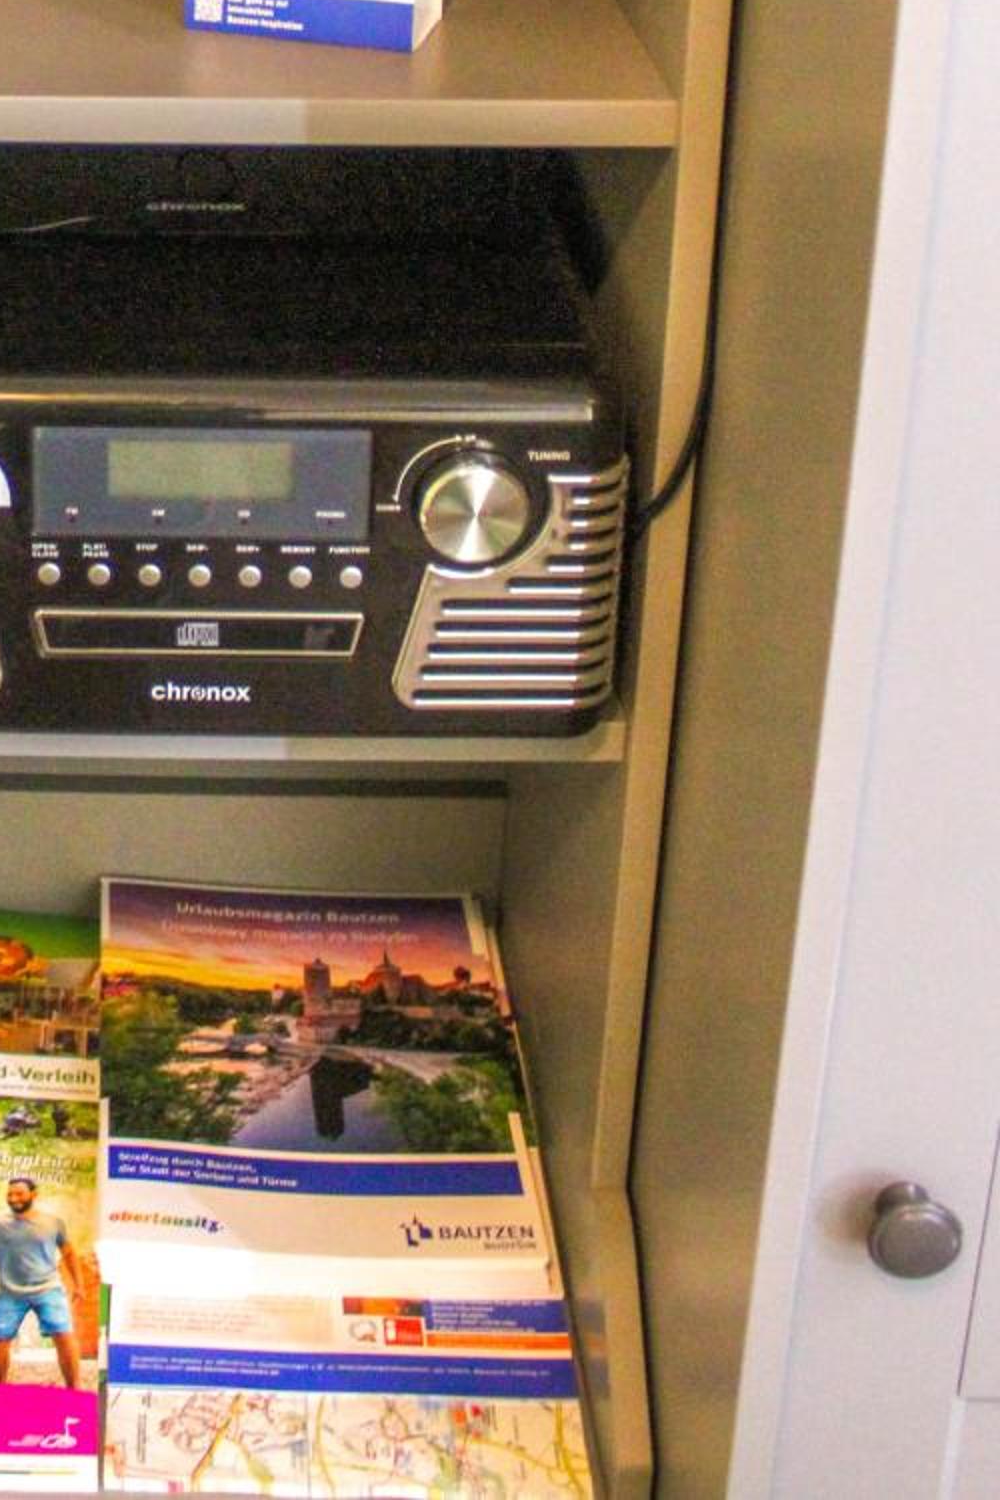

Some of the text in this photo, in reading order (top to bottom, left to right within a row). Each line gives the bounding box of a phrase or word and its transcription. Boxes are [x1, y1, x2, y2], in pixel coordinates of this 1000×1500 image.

[527, 450, 571, 462] TUNING
[135, 543, 159, 552] STOP
[329, 545, 371, 555] FUNCTION
[151, 681, 251, 703] chronox
[175, 900, 400, 925] Urlaubsmagazin Bautzen
[171, 1156, 204, 1169] durch
[117, 1164, 137, 1174] die
[138, 1164, 170, 1176] Stadt
[171, 1168, 191, 1178] der
[236, 1174, 260, 1186] und
[261, 1175, 299, 1188] Türme
[437, 1224, 535, 1241] BAUTZEN
